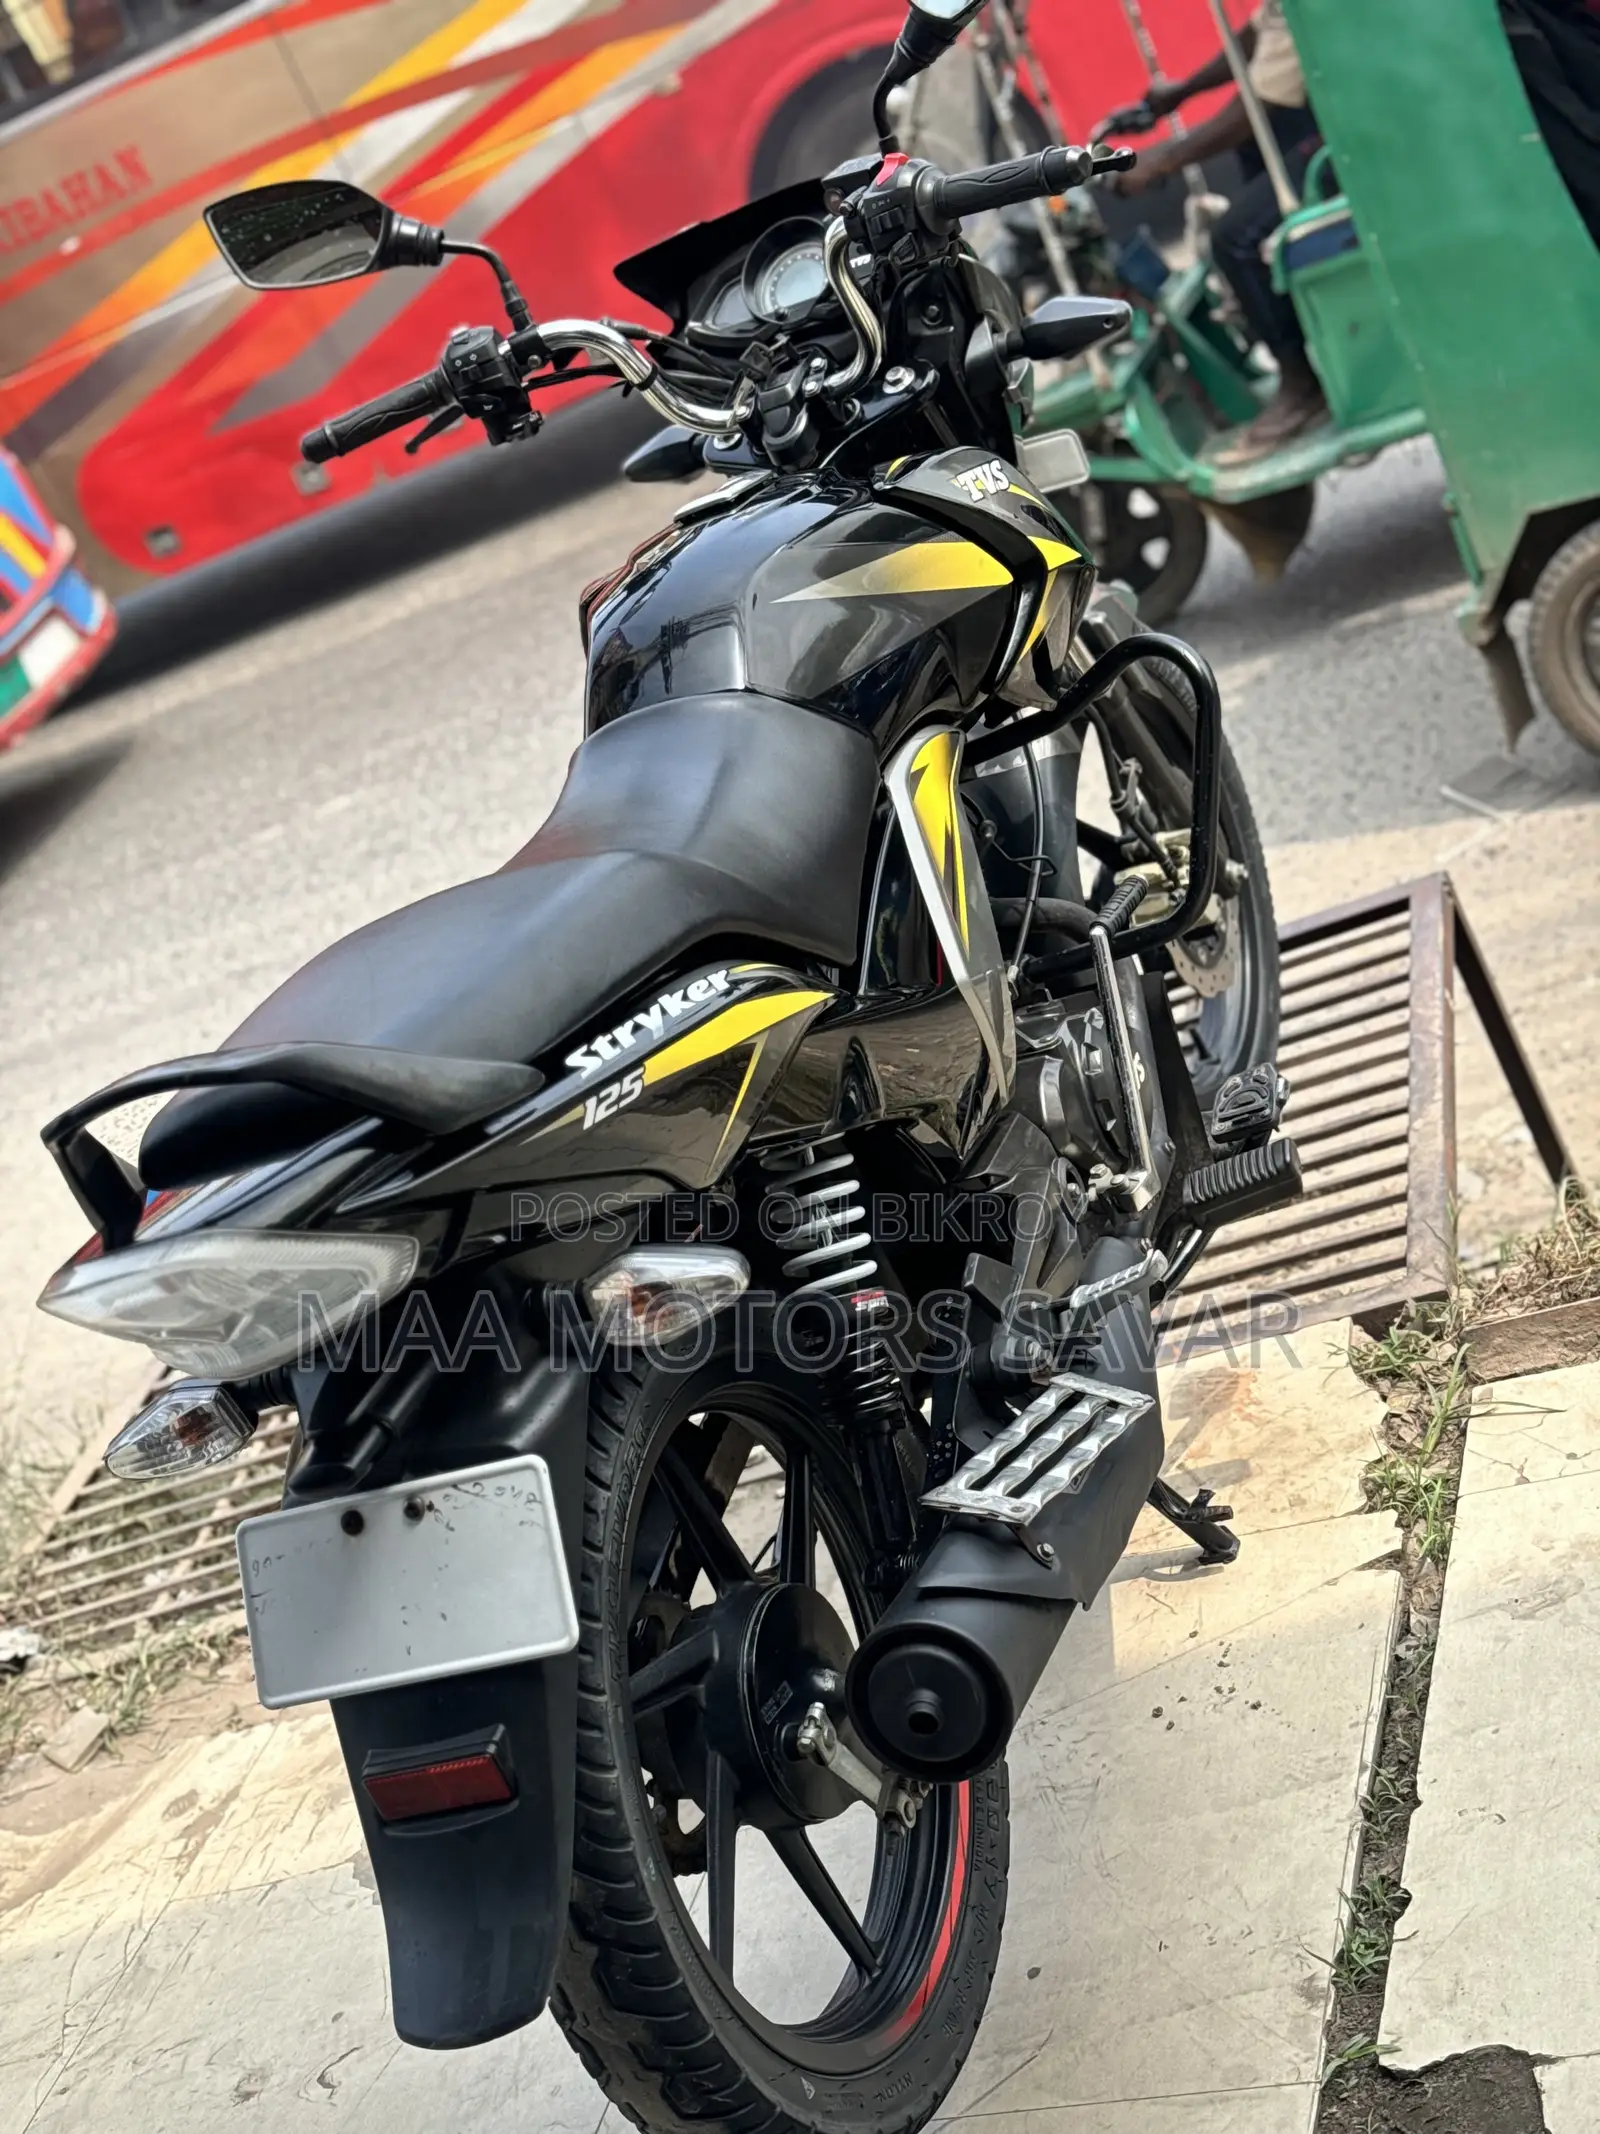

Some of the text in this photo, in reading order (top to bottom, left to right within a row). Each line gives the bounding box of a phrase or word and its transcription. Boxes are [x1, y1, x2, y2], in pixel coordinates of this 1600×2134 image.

[0, 145, 153, 254] IBAHAN
[955, 458, 1010, 503] TVS
[565, 968, 732, 1079] Stryker
[583, 1065, 645, 1130] 125
